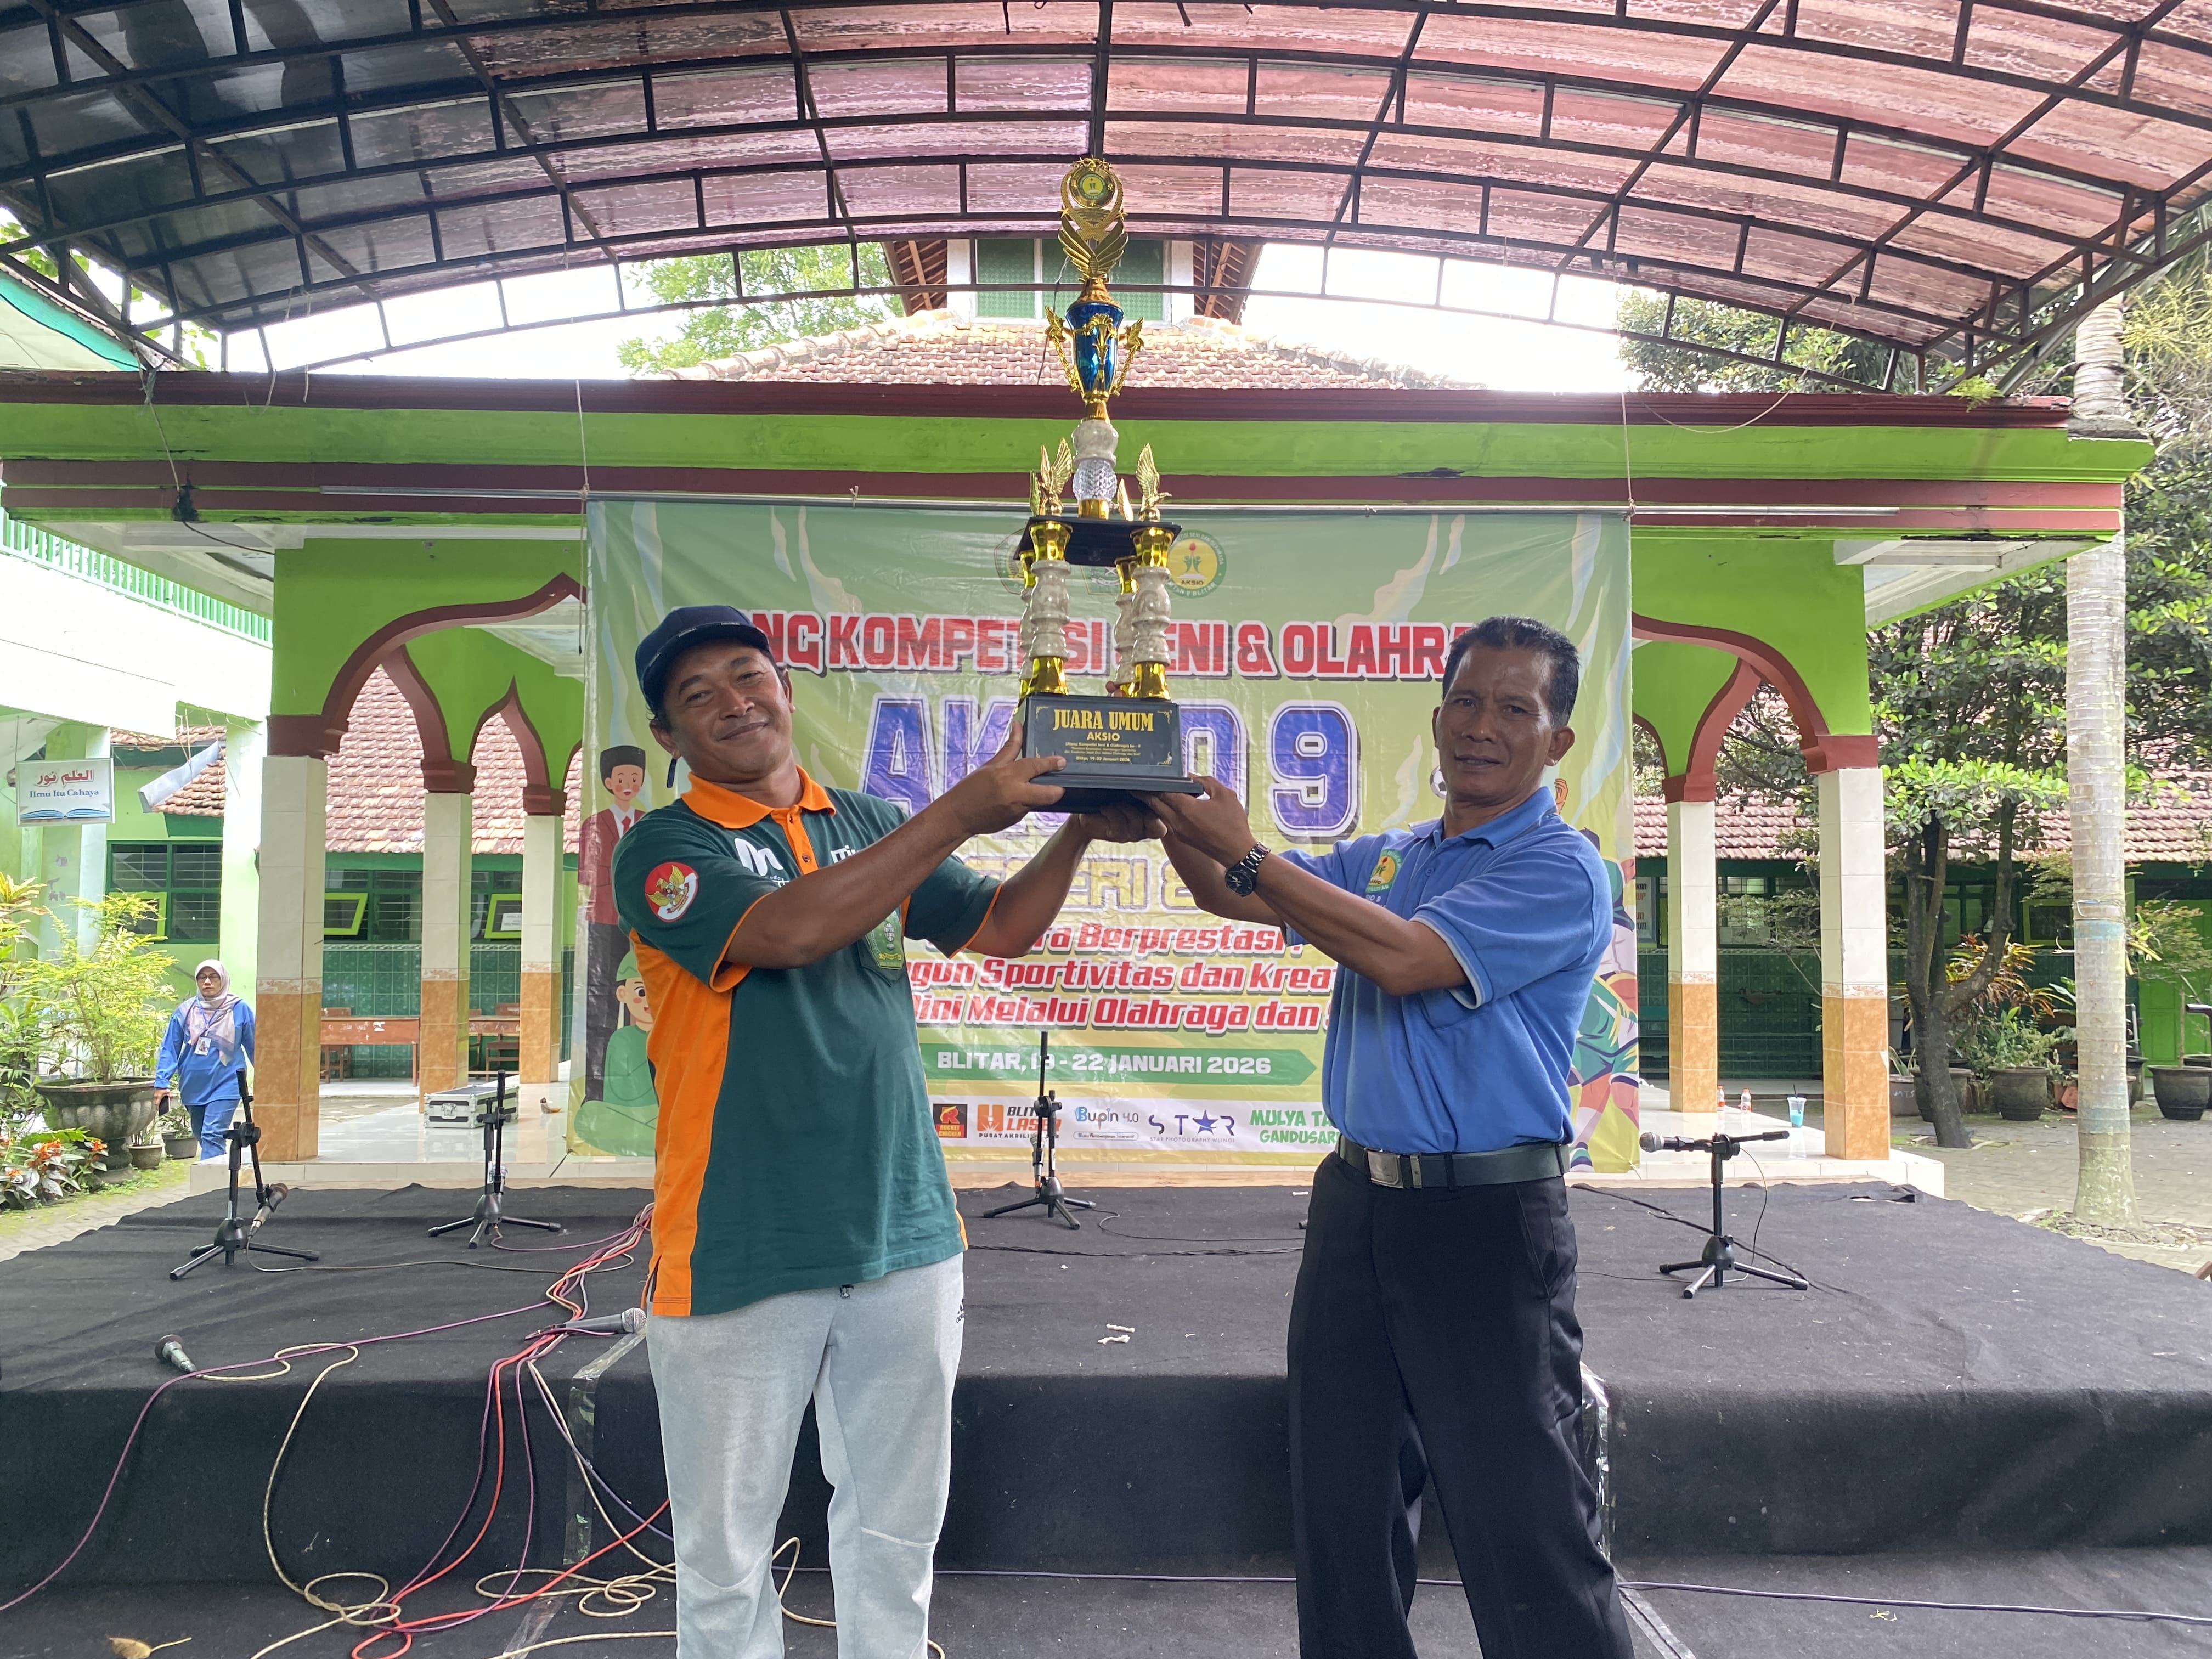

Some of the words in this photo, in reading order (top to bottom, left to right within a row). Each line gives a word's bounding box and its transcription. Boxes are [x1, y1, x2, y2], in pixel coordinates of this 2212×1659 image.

[1237, 624, 1274, 673] &
[1053, 709, 1103, 730] JUARA
[1109, 711, 1154, 731] UMUM
[1087, 732, 1120, 741] AKSIO
[36, 771, 57, 785] نور
[61, 769, 93, 786] العلم
[1271, 704, 1353, 831] 9
[67, 789, 99, 798] Cahaya
[980, 959, 1174, 989] Sportivitas
[1180, 962, 1244, 988] dan
[968, 996, 1090, 1023] Melalui
[1095, 998, 1249, 1030] Olahraga
[1256, 1001, 1319, 1026] dan
[938, 1052, 1026, 1074] BLITAR,
[1071, 1054, 1104, 1070] 22
[1109, 1055, 1201, 1074] JANUARI
[1207, 1057, 1271, 1074] 2026
[1075, 1107, 1119, 1130] Bupin
[1123, 1112, 1139, 1122] 4.0
[1249, 1110, 1306, 1126] MULYA
